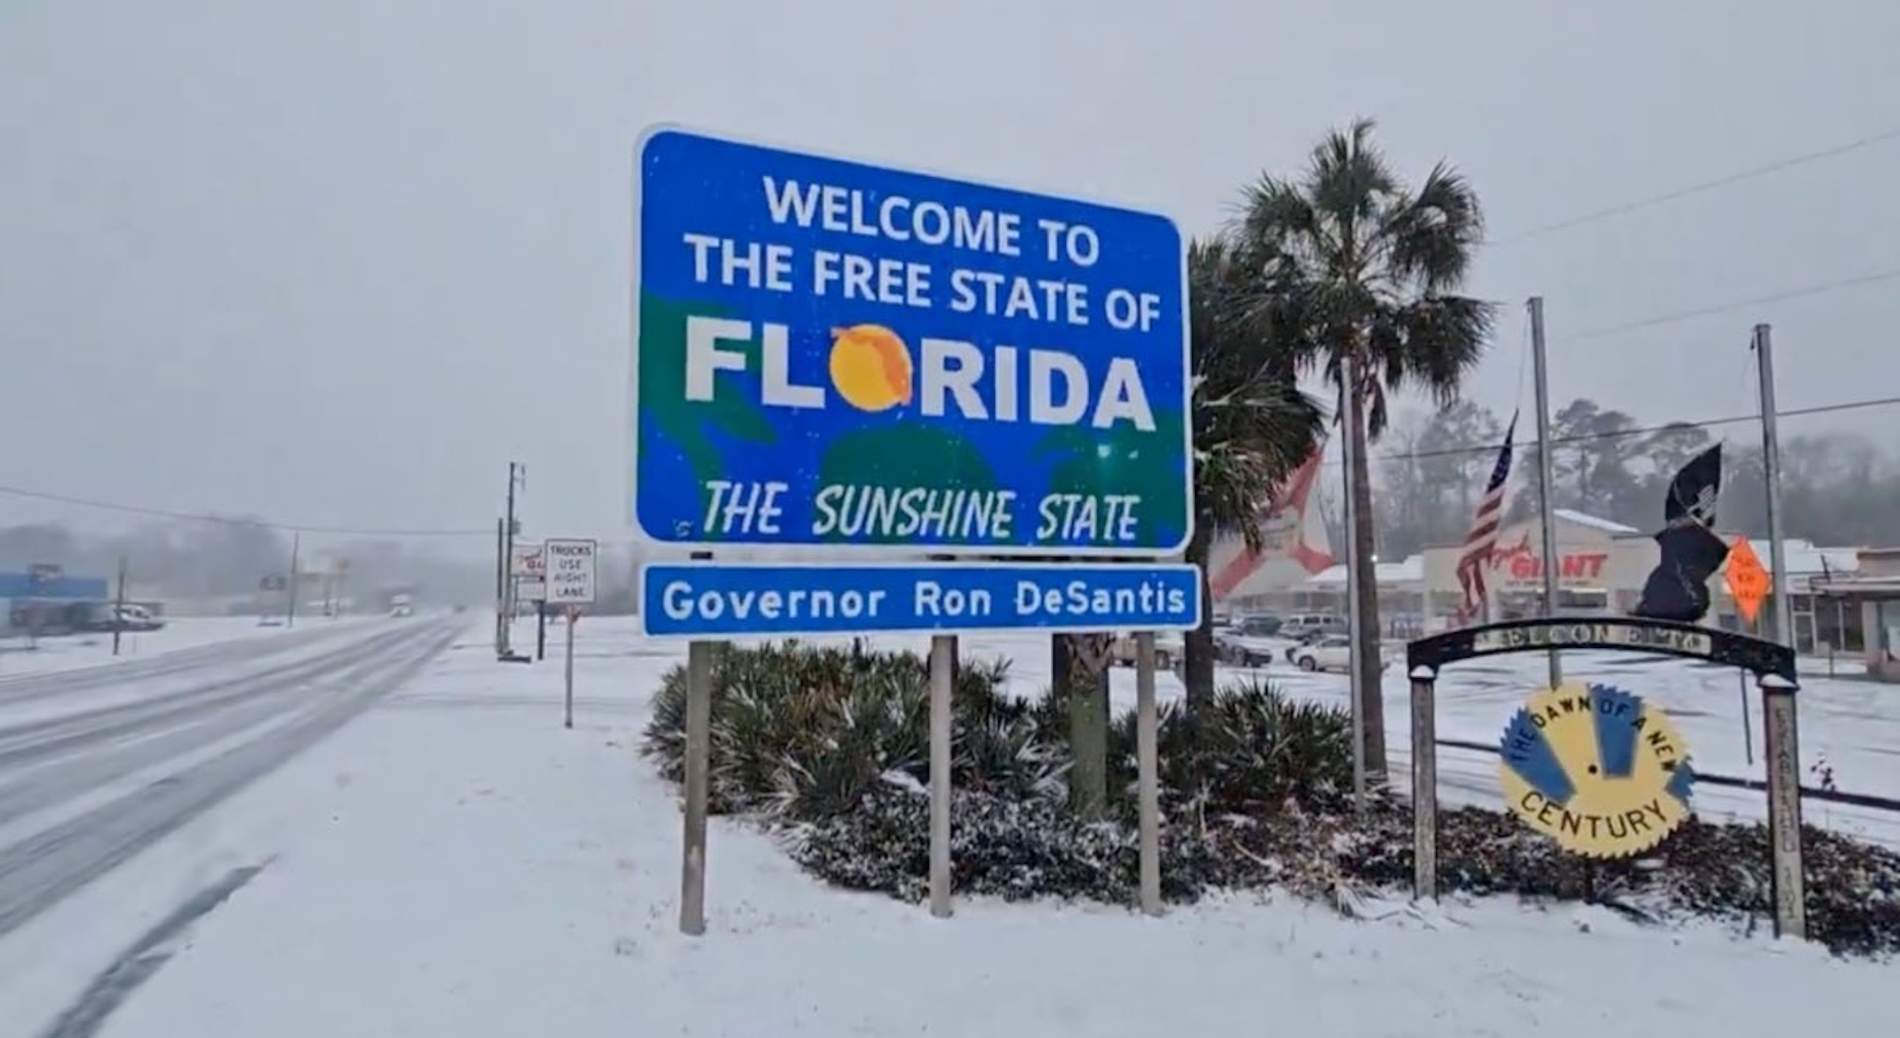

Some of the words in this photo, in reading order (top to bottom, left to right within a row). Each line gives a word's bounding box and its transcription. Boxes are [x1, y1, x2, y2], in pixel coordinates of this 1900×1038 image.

[762, 175, 1021, 256] WELCOME
[1038, 218, 1099, 266] TO
[683, 233, 792, 292] THE
[814, 250, 932, 308] FREE
[949, 267, 1090, 325] STATE
[1105, 289, 1161, 332] OF
[685, 315, 1157, 432] FLORIDA
[703, 480, 789, 534] THE
[812, 484, 1017, 539] SUNSHINE
[1036, 493, 1142, 541] STATE
[550, 544, 592, 557] TRUCKS
[559, 558, 582, 571] USE
[556, 586, 585, 598] LANE
[662, 581, 886, 621] Governor
[914, 580, 992, 617] Ron
[1014, 580, 1186, 615] DeSantis
[1510, 727, 1536, 762] THE
[1529, 695, 1593, 729] DAWN
[1600, 698, 1631, 718] OF
[1631, 716, 1648, 732] A
[1646, 730, 1679, 772] NEW
[1520, 790, 1670, 839] CENTURY
